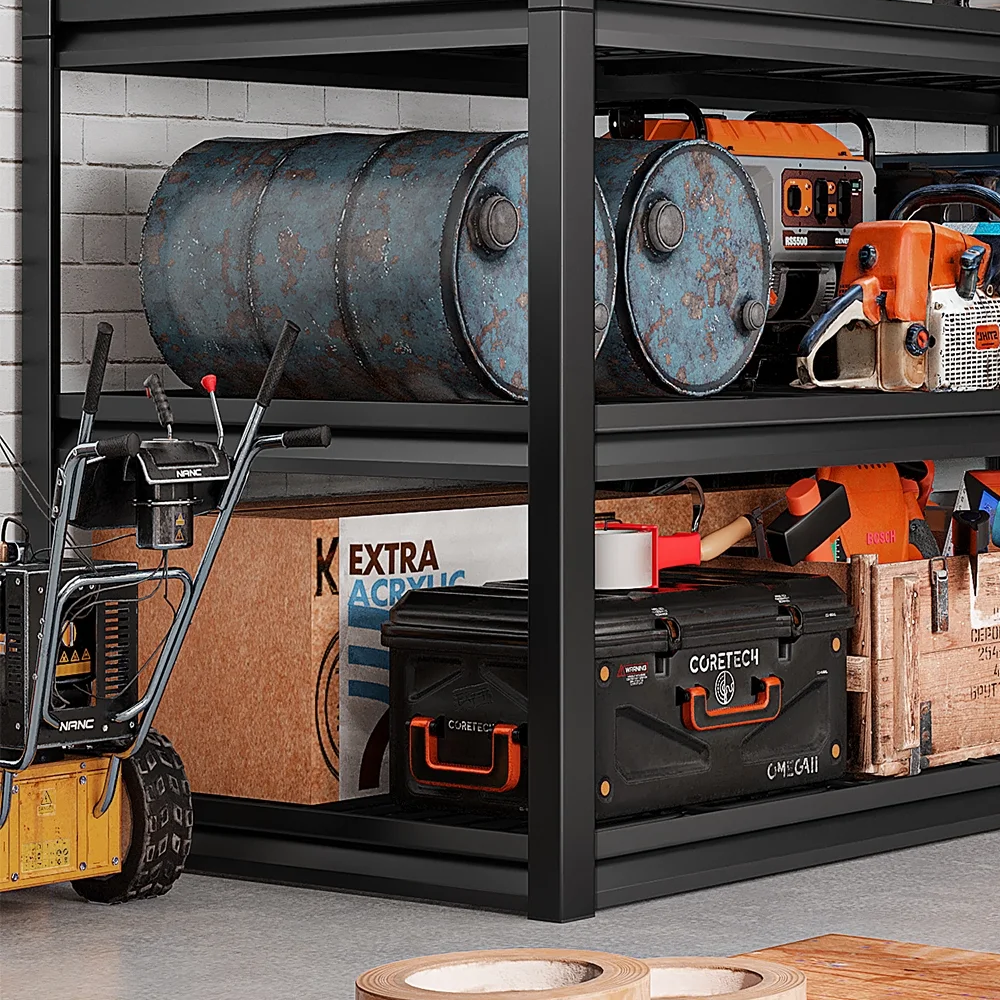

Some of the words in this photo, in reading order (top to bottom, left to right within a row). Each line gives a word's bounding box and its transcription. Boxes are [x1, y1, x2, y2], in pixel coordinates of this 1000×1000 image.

[866, 530, 896, 545] BOSCH
[349, 540, 440, 575] EXTRA
[625, 664, 647, 673] WARNING
[689, 648, 759, 674] CORETECH
